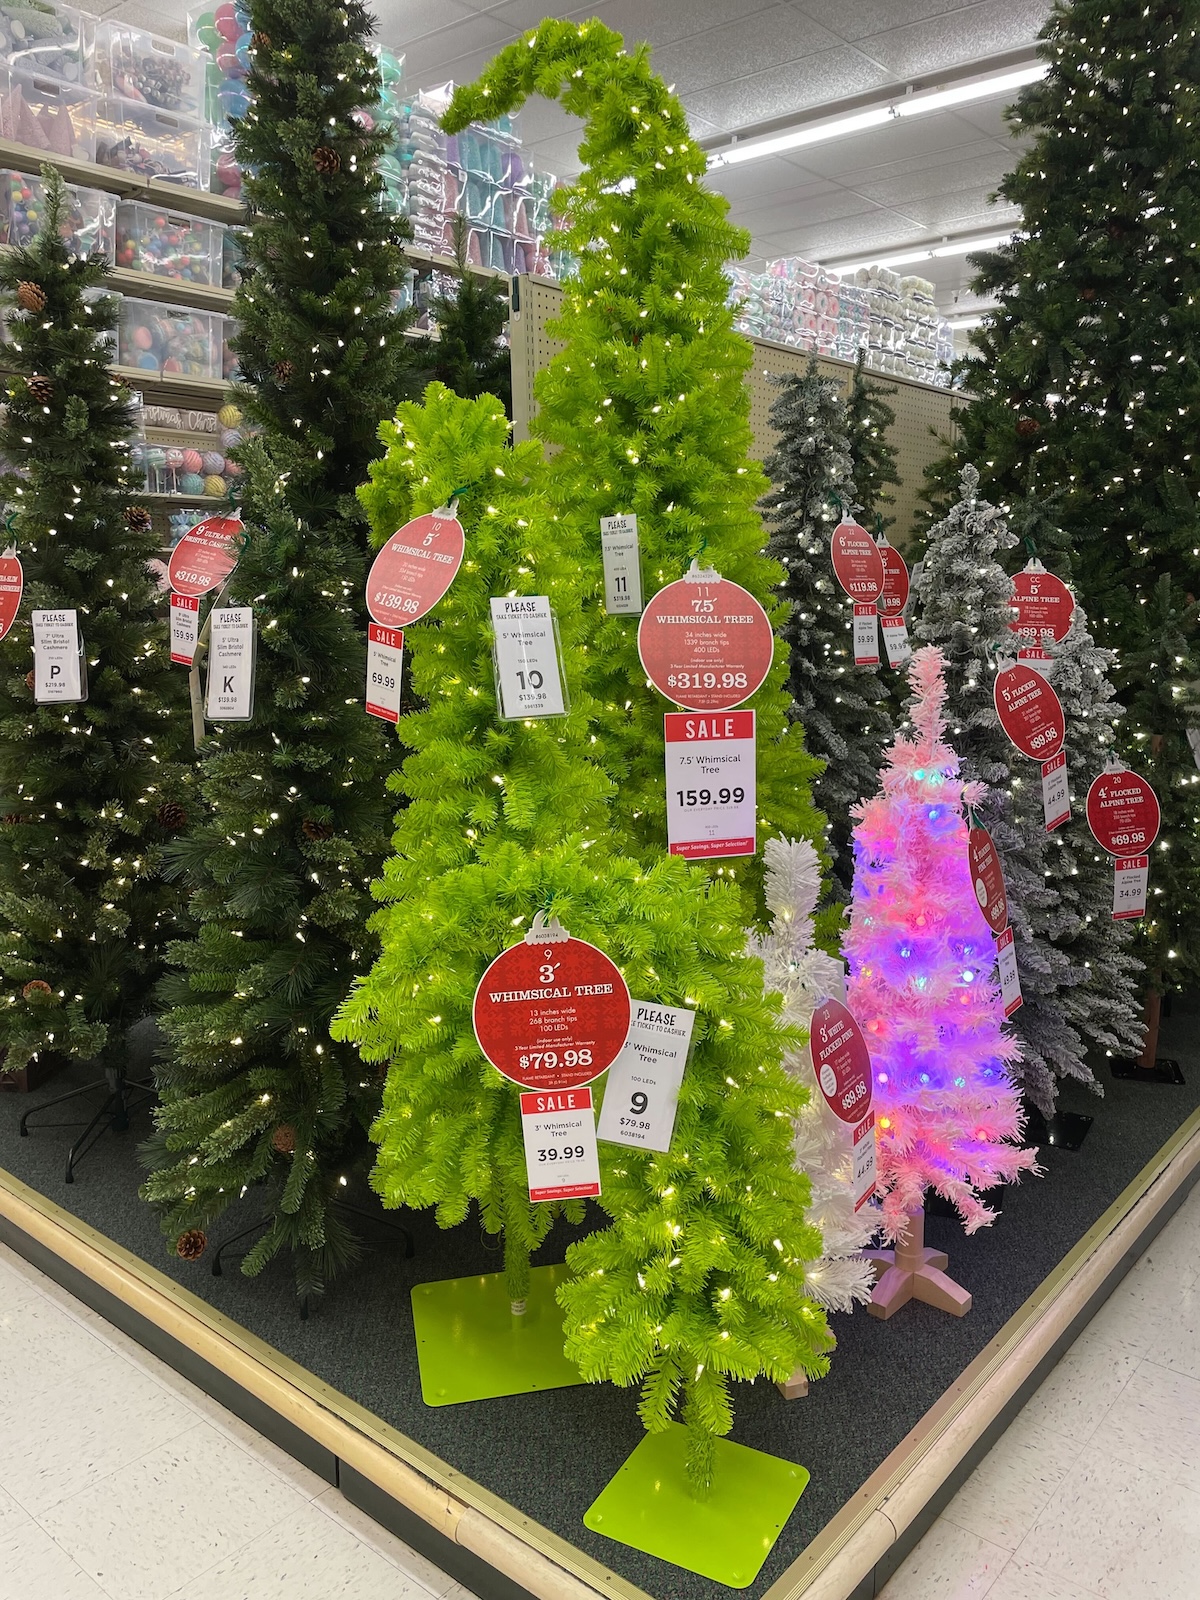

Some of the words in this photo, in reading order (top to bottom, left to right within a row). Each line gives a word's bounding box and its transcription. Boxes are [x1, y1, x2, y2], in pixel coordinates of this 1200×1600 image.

[432, 522, 442, 532] 10
[608, 519, 627, 530] PLEASE
[423, 533, 440, 547] 5'
[840, 536, 847, 547] 6'
[392, 543, 432, 560] WHIMSICAL
[433, 553, 454, 565] TREE
[175, 570, 212, 587] $319.98
[615, 576, 627, 593] 11
[698, 587, 709, 597] 11
[850, 582, 878, 592] $119.98
[1030, 584, 1041, 595] 5'
[177, 598, 193, 610] SALE
[374, 591, 420, 614] $139.98
[505, 602, 536, 613] PLEASE
[691, 598, 718, 613] 7.5'
[859, 606, 872, 615] SALE
[42, 614, 66, 622] PLEASE
[220, 613, 242, 623] PLEASE
[656, 615, 721, 624] WHIMSICAL
[724, 615, 754, 624] TREE
[886, 619, 899, 627] SALE
[173, 629, 194, 641] 159.99
[376, 629, 396, 646] SALE
[511, 631, 546, 639] Whimsical
[858, 635, 874, 644] 59.99
[1018, 627, 1055, 638] $89.98
[720, 639, 730, 647] tips
[1026, 651, 1046, 659] SALE
[50, 665, 61, 680] P
[223, 676, 235, 693] K
[372, 672, 395, 689] 69.99
[516, 670, 544, 690] 10
[668, 672, 748, 689] $319.98
[1002, 687, 1011, 702] 5'
[1011, 680, 1037, 698] FLOCKED
[1008, 696, 1029, 712] ALPINE
[1027, 688, 1043, 701] TREE
[685, 718, 734, 739] SALE
[1030, 727, 1058, 751] $89.98
[680, 756, 694, 765] 7.5'
[696, 754, 741, 764] Whimsical
[1047, 758, 1061, 774] SALE
[701, 766, 720, 774] Tree
[1113, 777, 1122, 785] 20
[676, 787, 745, 807] 159.99
[1048, 789, 1065, 805] 44.99
[1098, 786, 1109, 799] 4'
[1110, 788, 1142, 798] FLOCKED
[1100, 799, 1125, 809] ALPINE
[1125, 796, 1144, 805] TREE
[1111, 832, 1146, 846] $69.98
[691, 843, 711, 851] Savings.
[1122, 859, 1141, 870] SALE
[1120, 888, 1142, 898] 34.99
[1000, 933, 1010, 949] SALE
[544, 949, 553, 961] 9
[539, 963, 561, 983] 3'
[489, 987, 572, 1003] WHIMSICAL
[574, 984, 613, 996] TREE
[530, 1017, 542, 1025] 268
[544, 1016, 566, 1024] branch
[637, 1008, 677, 1026] PLEASE
[637, 1021, 655, 1031] TICKET
[664, 1027, 687, 1038] CASHIER
[820, 1024, 828, 1043] 3'
[827, 1020, 845, 1038] WHITE
[633, 1043, 677, 1058] Whimsical
[819, 1037, 843, 1061] FLOCKED
[841, 1028, 854, 1043] PINE
[519, 1049, 593, 1070] $79.98
[640, 1054, 658, 1064] Tree
[642, 1078, 657, 1086] LEDs
[842, 1080, 867, 1110] $89.98
[537, 1094, 576, 1112] SALE
[629, 1092, 649, 1115] 9
[543, 1120, 583, 1130] Whimsical
[620, 1117, 651, 1130] $79.98
[858, 1118, 872, 1140] SALE
[620, 1130, 646, 1140] 6038194
[538, 1145, 585, 1162] 39.99
[857, 1156, 873, 1179] 44.99
